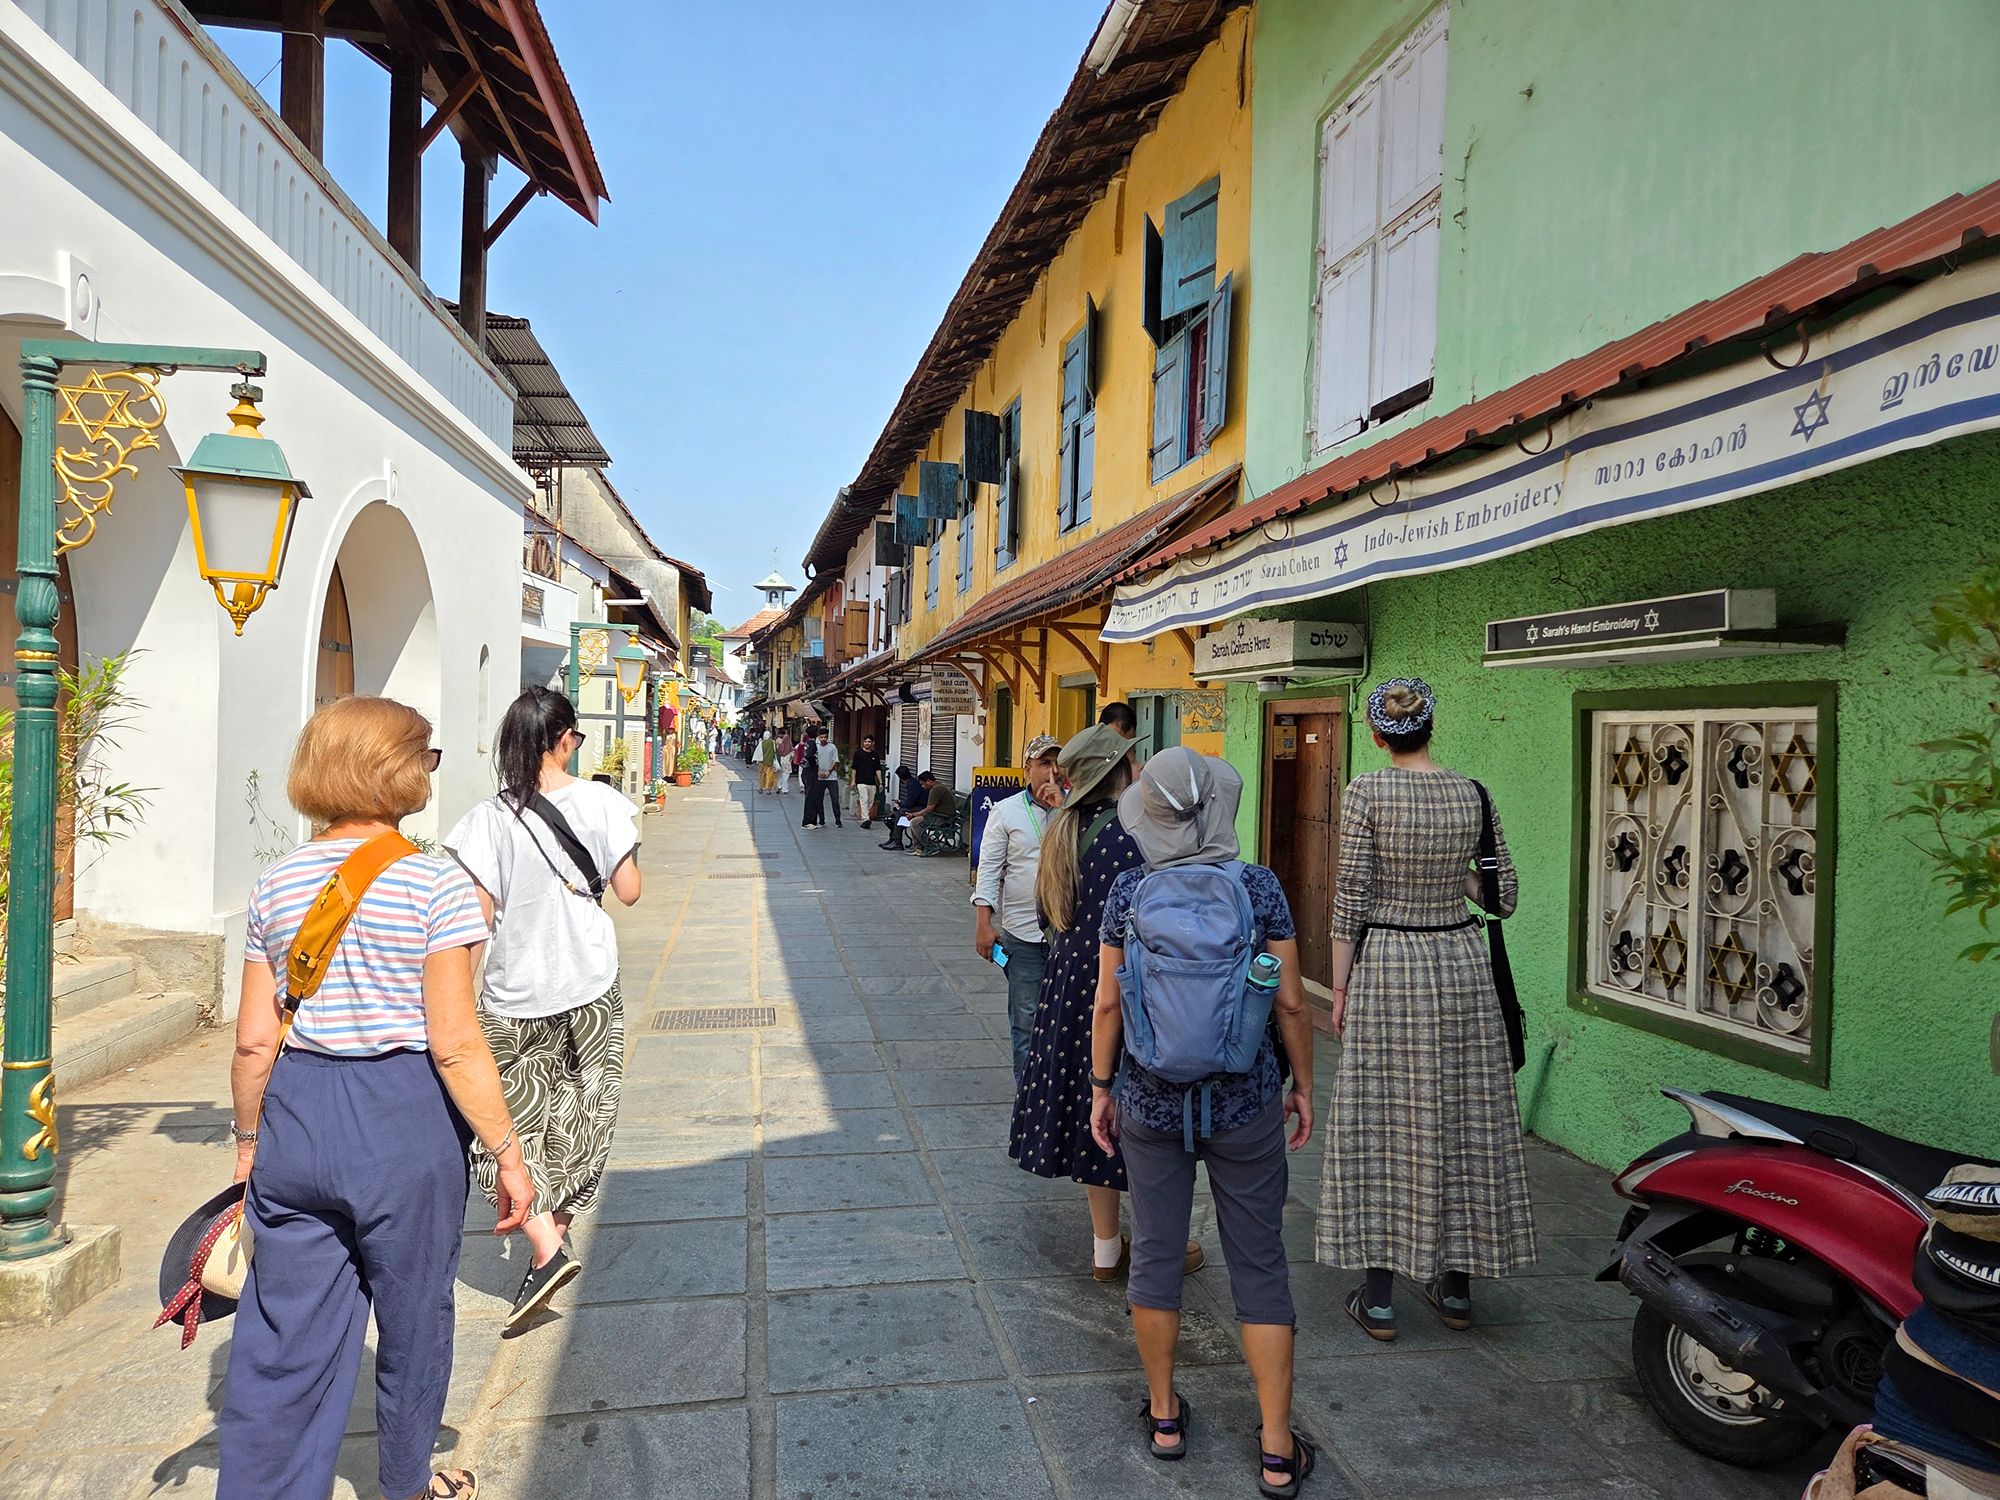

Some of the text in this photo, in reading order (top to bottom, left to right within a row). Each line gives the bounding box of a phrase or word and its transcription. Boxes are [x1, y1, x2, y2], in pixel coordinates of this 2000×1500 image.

[1594, 422, 1747, 486] സാറാ കോഹൻ
[1363, 479, 1566, 552] Indo-Jewish Embroidery
[1260, 555, 1320, 579] Sarah Cohen
[1213, 568, 1253, 607] שרה כהן
[1310, 628, 1348, 648] שלום
[1542, 617, 1640, 638] Sarah's Hand Embroidery
[1211, 642, 1230, 659] Sarah
[1253, 635, 1271, 651] Home
